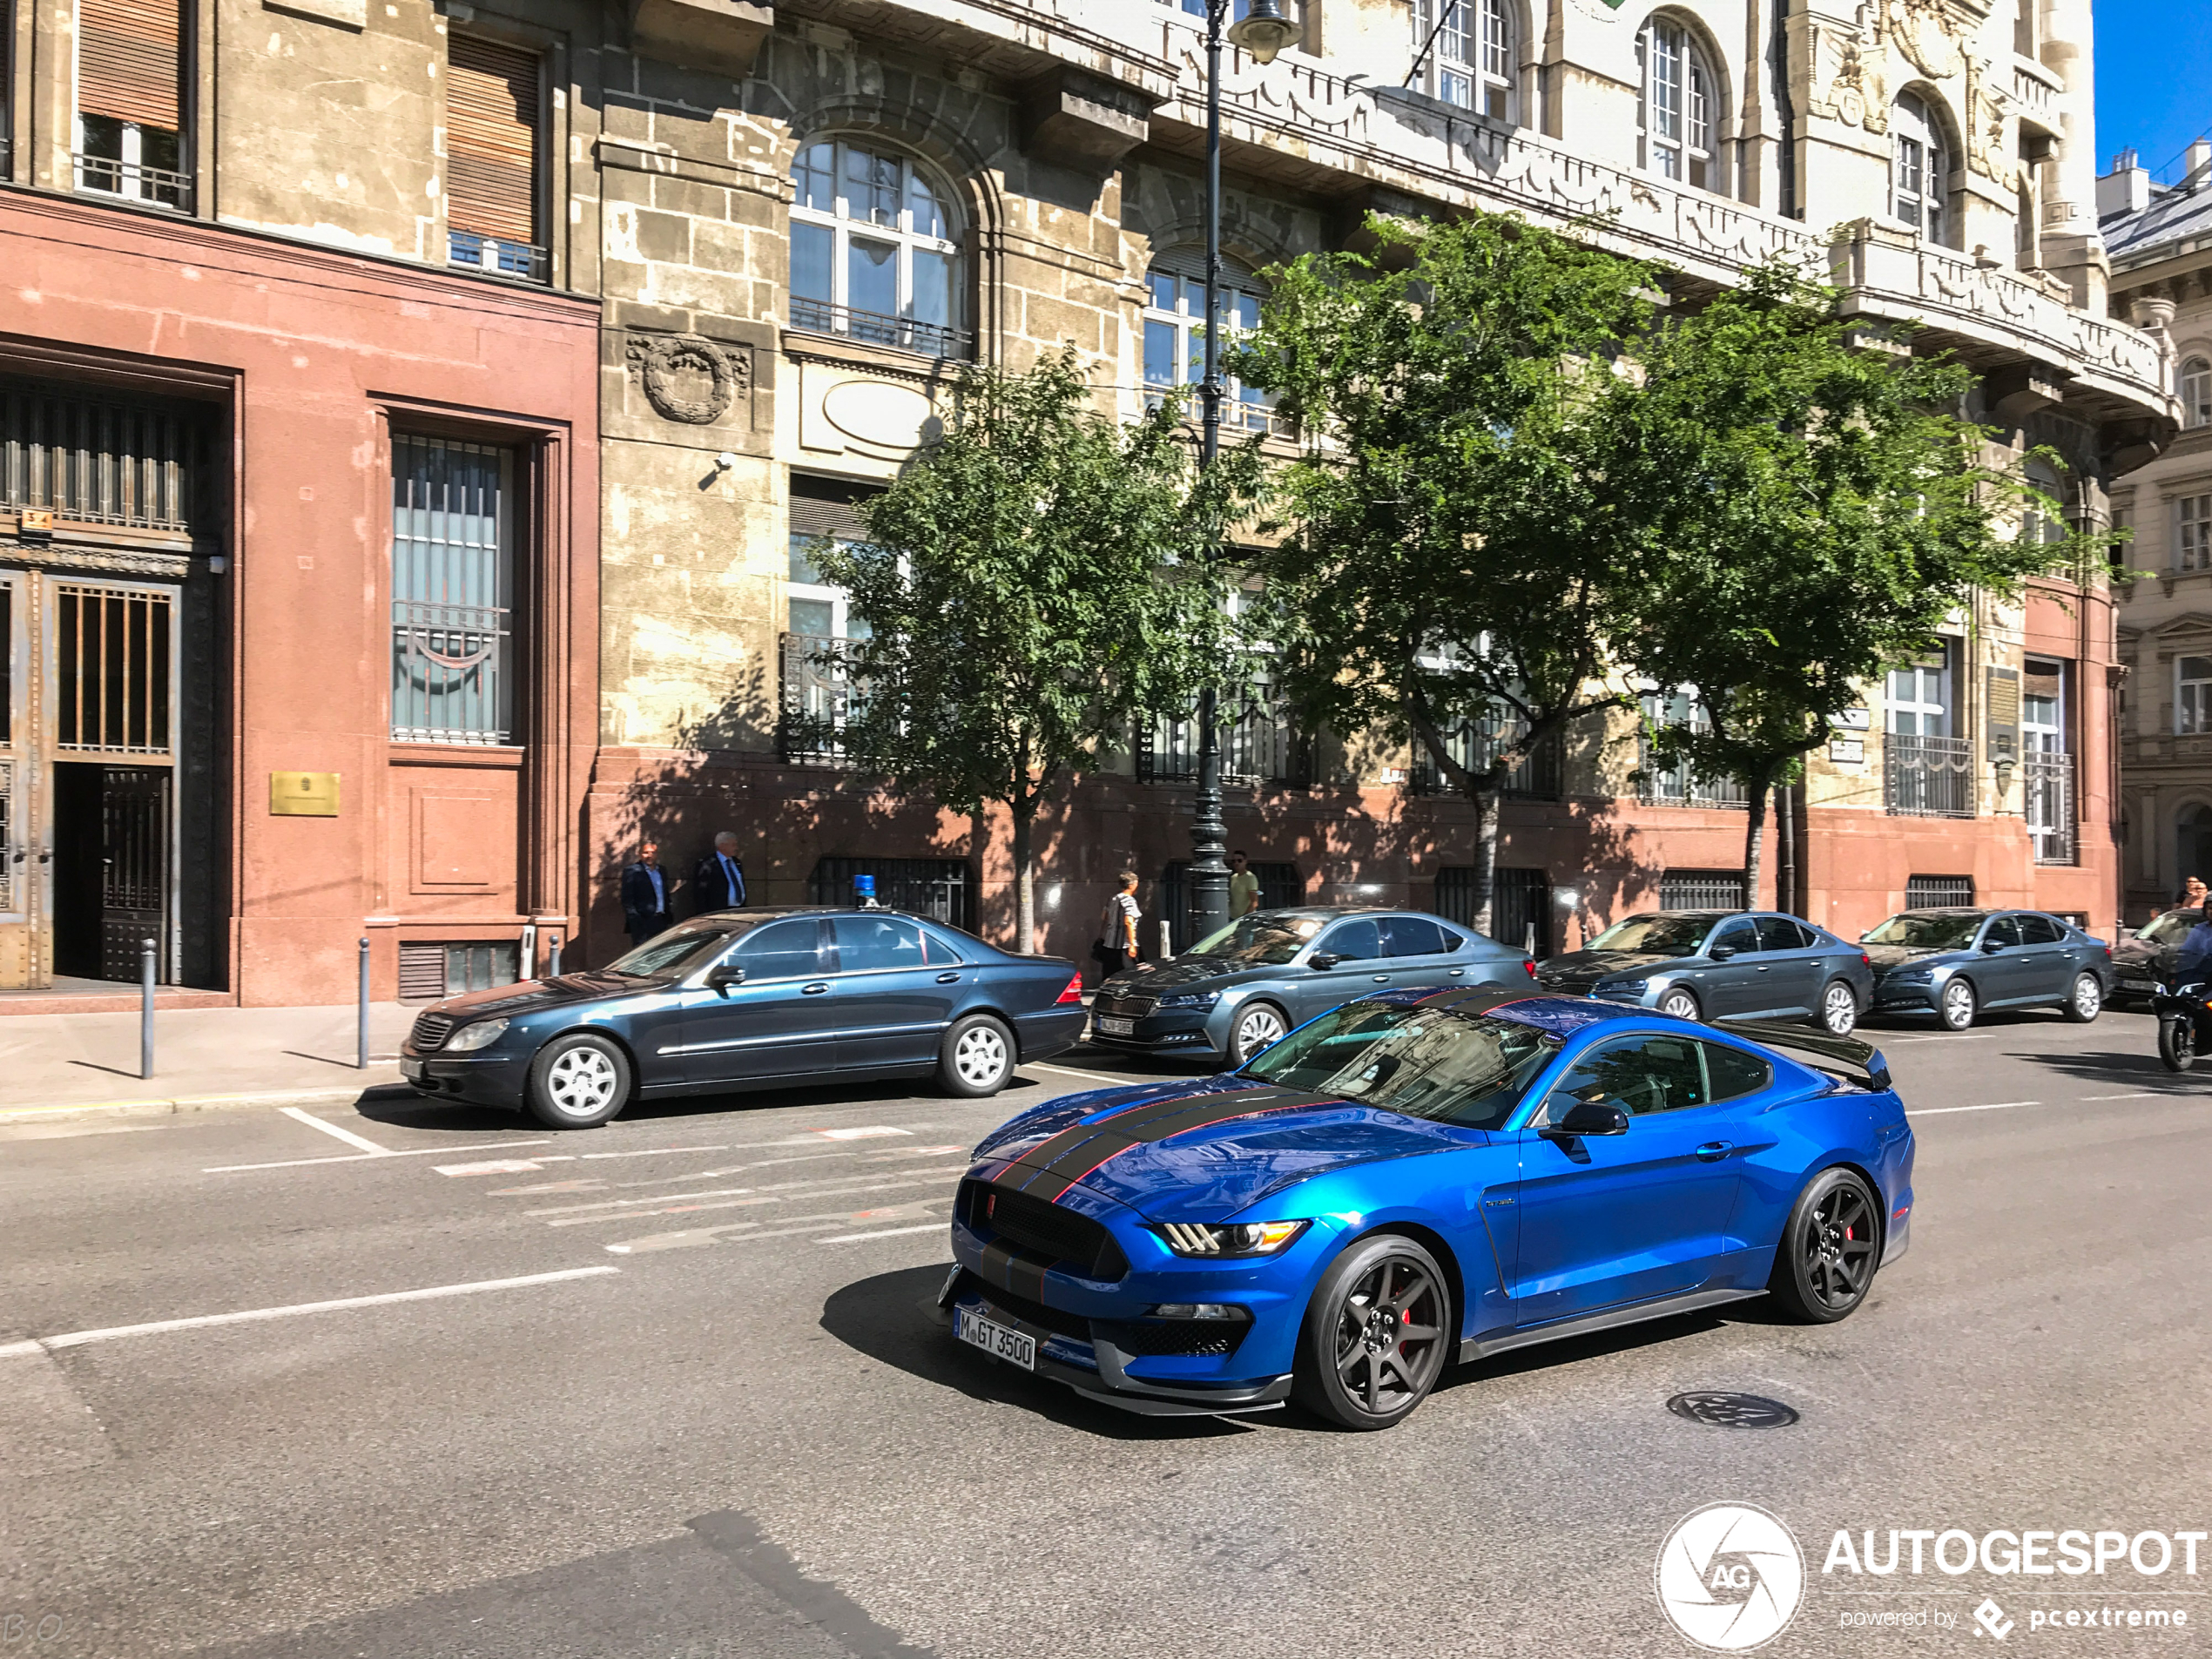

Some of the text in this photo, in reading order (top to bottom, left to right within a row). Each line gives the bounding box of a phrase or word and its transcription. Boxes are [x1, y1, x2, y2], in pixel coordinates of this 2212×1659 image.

[961, 1313, 1031, 1365] M GT 3500
